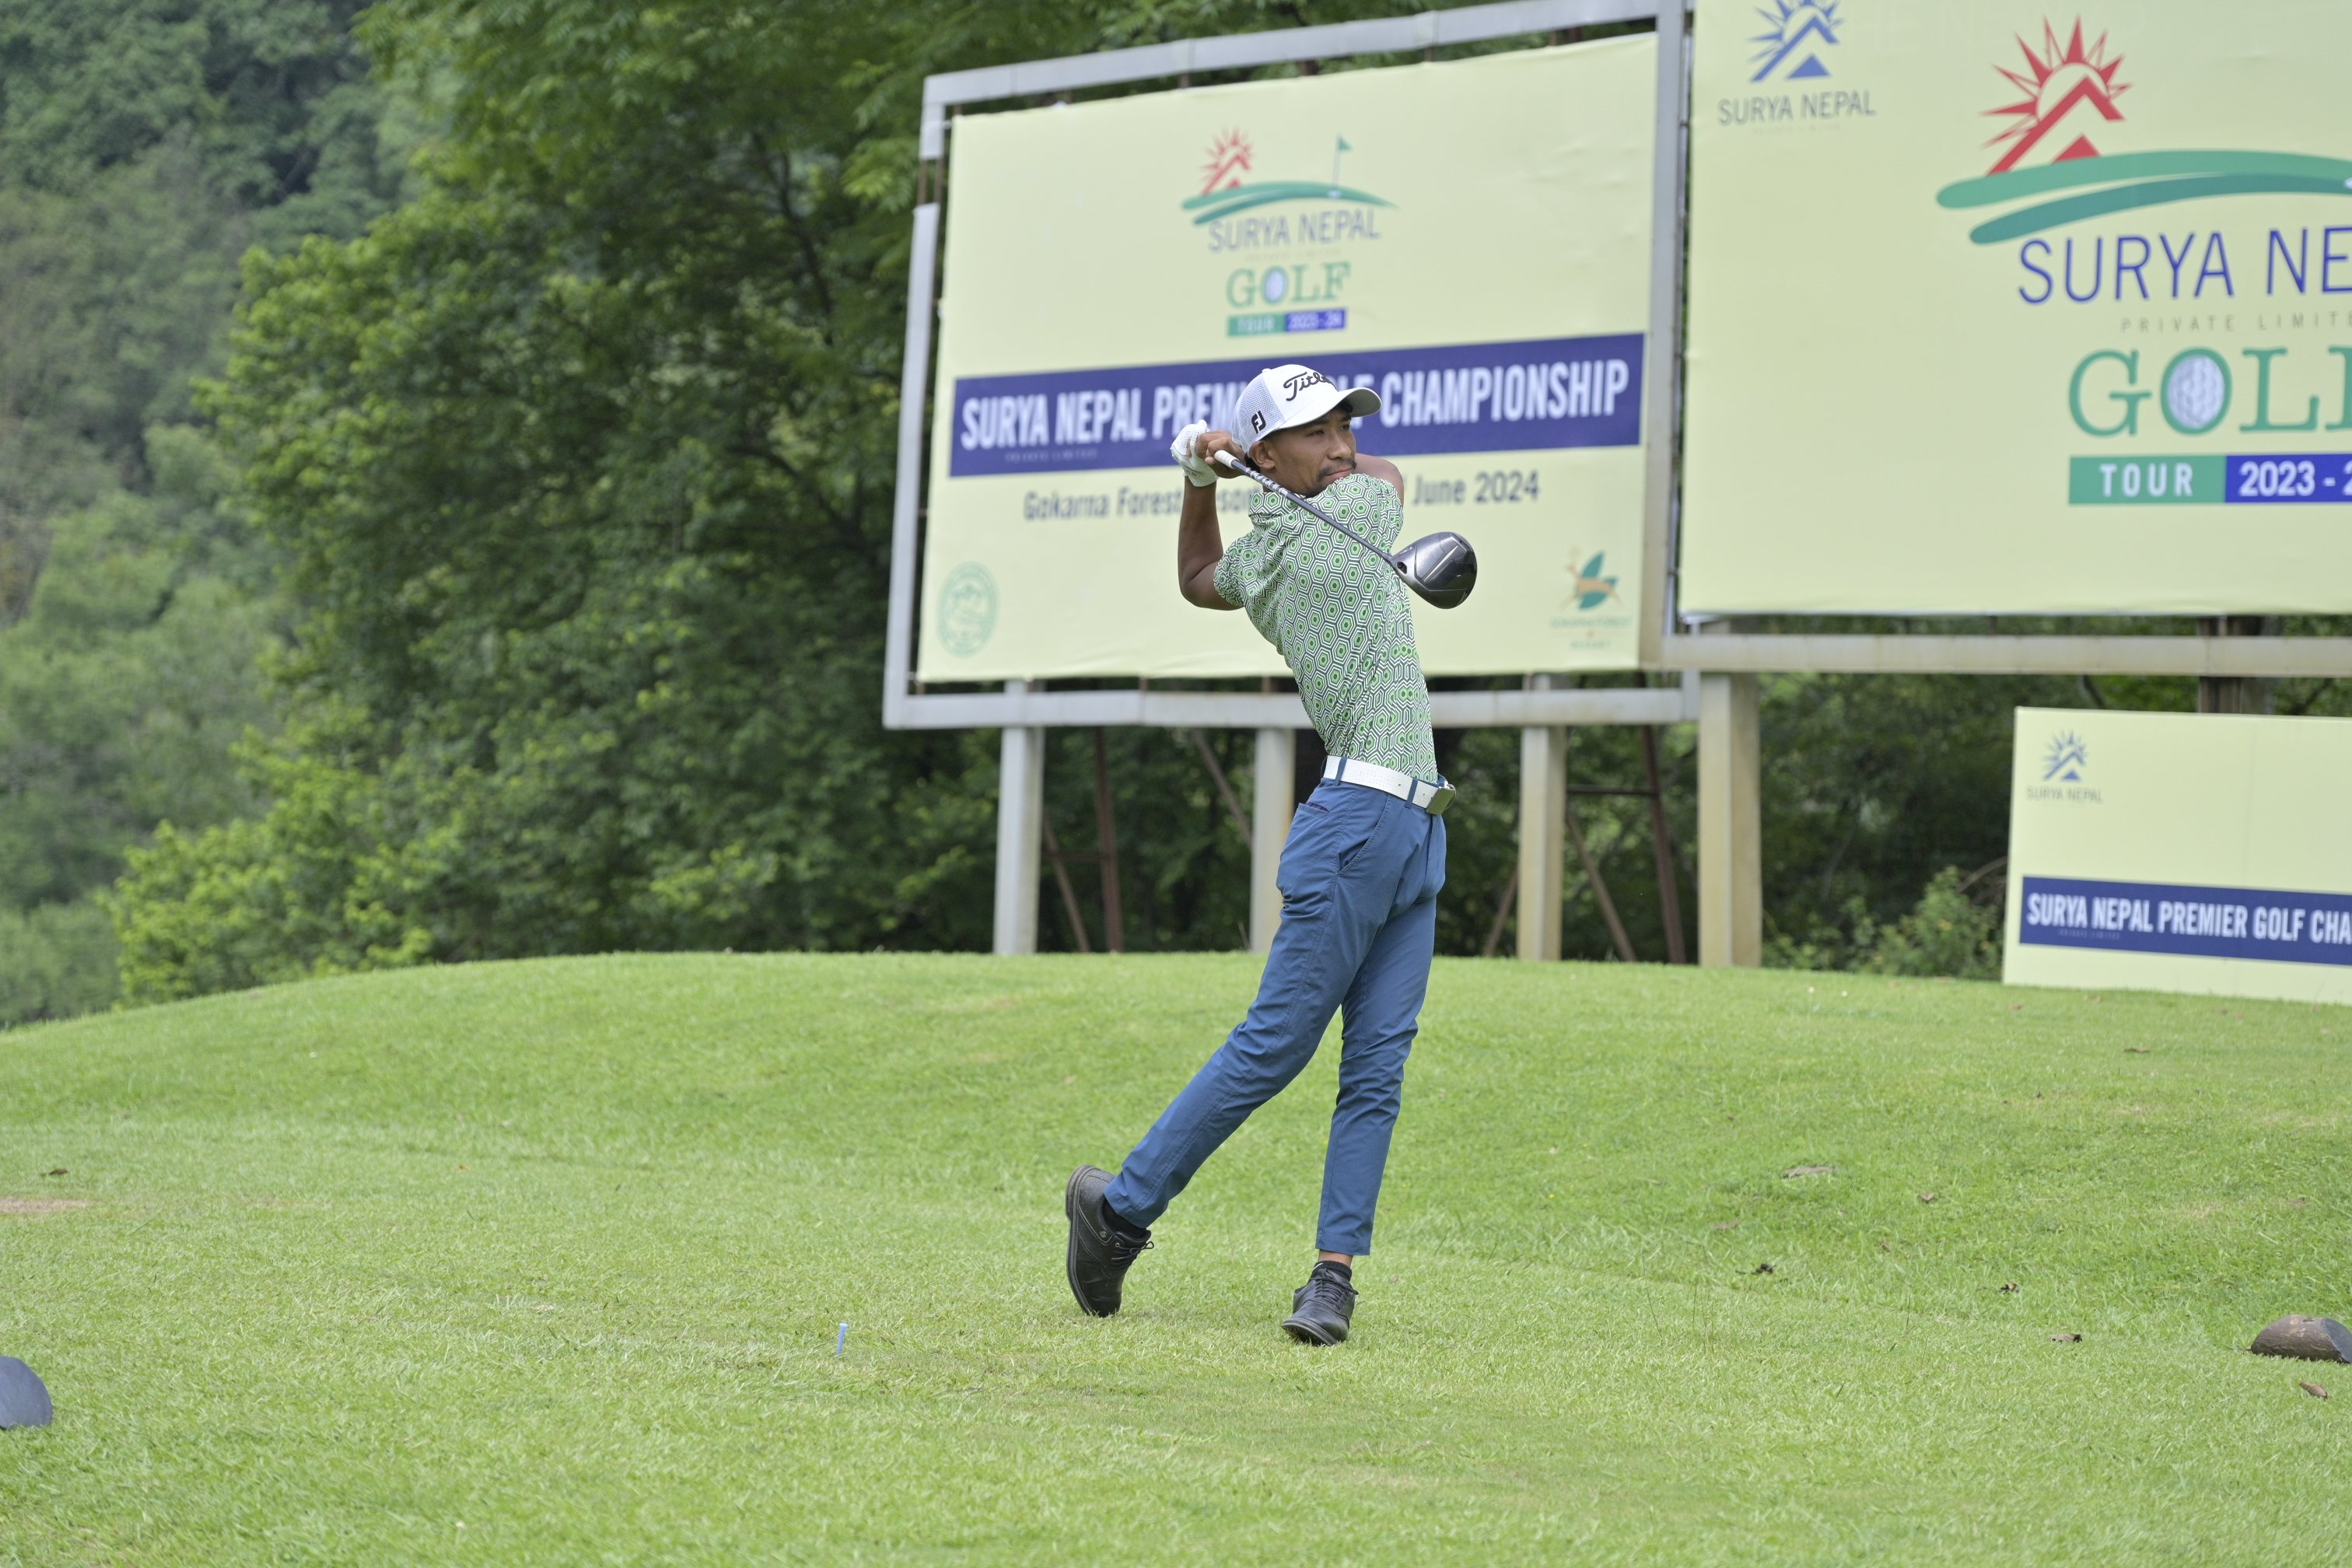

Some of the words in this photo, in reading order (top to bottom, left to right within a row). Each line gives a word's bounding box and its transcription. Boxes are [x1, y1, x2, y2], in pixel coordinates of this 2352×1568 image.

[1717, 95, 1794, 126] SURYA
[1801, 89, 1877, 119] NEPAL
[1208, 215, 1290, 252] SURYA
[1297, 209, 1381, 244] NEPAL
[1226, 261, 1352, 308] GOLF
[2018, 230, 2234, 304] SURYA
[2122, 315, 2235, 333] PRIVATE
[961, 394, 1049, 450] SURYA
[1055, 387, 1146, 445] NEPAL
[1152, 381, 1247, 439] PREM
[1380, 359, 1629, 428] CHAMPIONSHIP
[1413, 474, 1465, 506] June
[1475, 470, 1539, 502] 2024
[2100, 464, 2193, 497] TOUR
[2027, 892, 2088, 928] SURYA
[2091, 896, 2153, 933] NEPAL
[2157, 900, 2249, 939] PREMIER
[2252, 906, 2305, 942] GOLF
[2309, 909, 2352, 945] CHA
